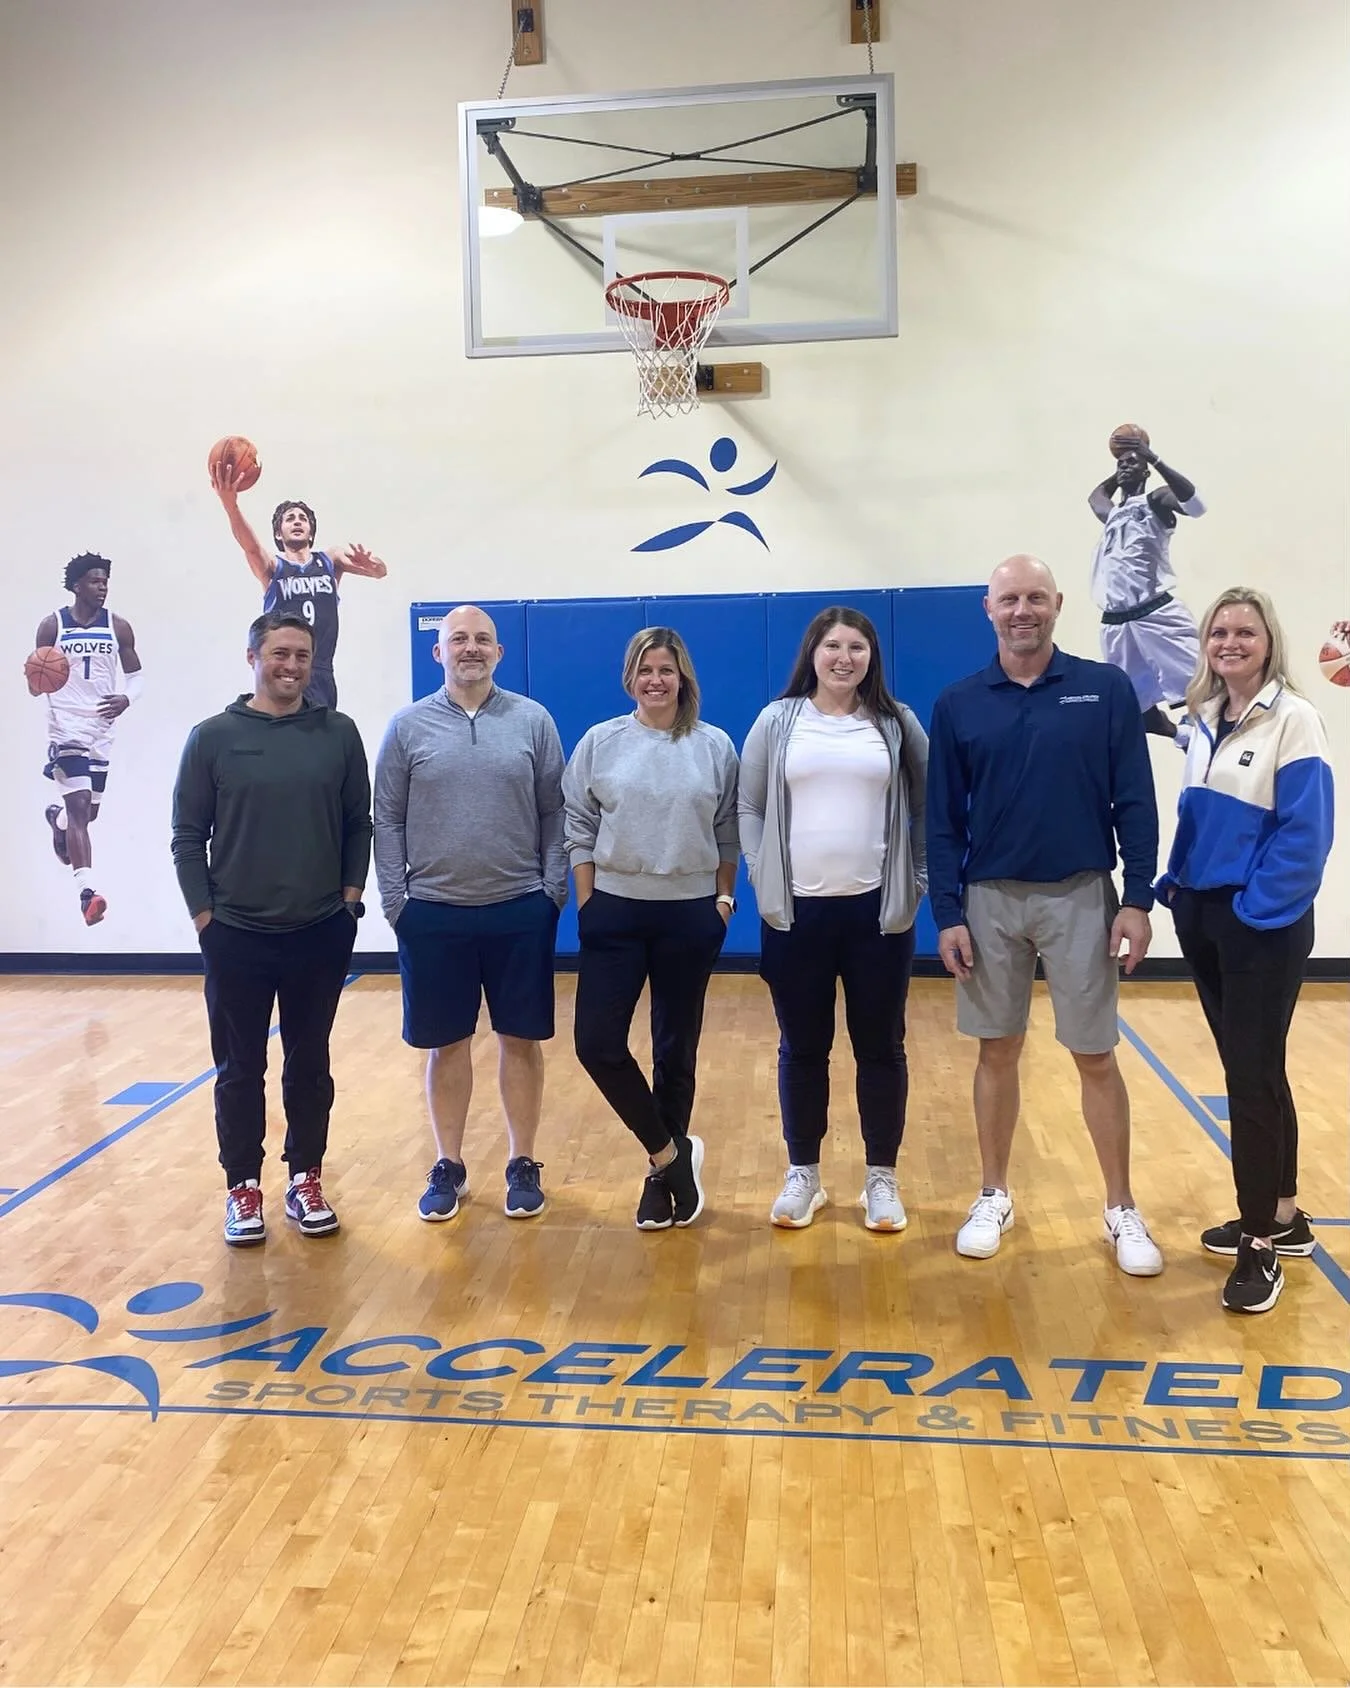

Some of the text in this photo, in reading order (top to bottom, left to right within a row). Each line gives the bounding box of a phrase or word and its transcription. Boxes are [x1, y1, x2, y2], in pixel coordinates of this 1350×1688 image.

[277, 575, 333, 601] WOLVES
[302, 600, 315, 626] 9
[60, 642, 113, 654] WOLVES
[82, 656, 91, 680] 1
[182, 1326, 1350, 1412] ACCELERATED
[205, 1380, 1350, 1445] SPORTS THERAPY & FITNESS
